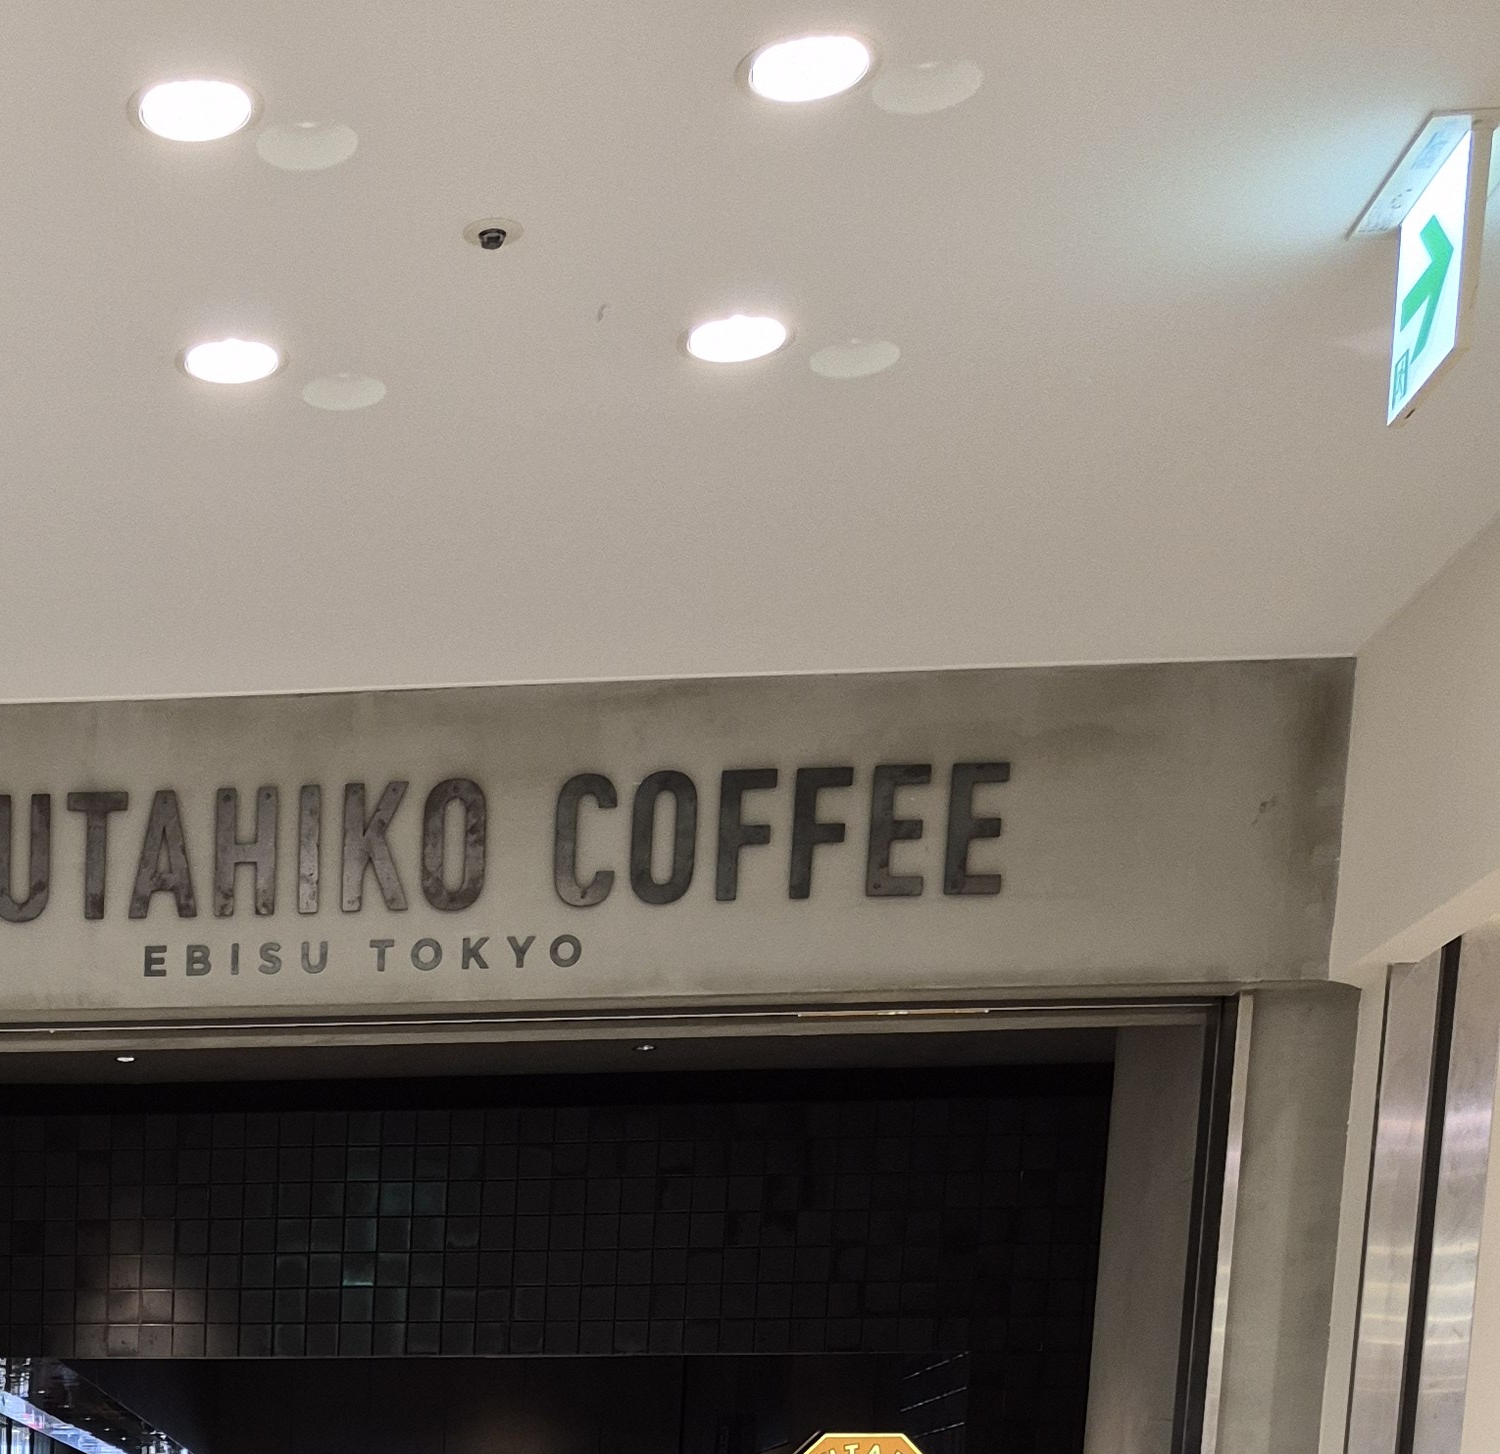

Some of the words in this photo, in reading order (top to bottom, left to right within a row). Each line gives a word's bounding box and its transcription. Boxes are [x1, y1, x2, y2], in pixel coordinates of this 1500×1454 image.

[553, 761, 1012, 909] COFFEE
[143, 940, 330, 978] EBISU
[369, 932, 584, 973] TOKYO
